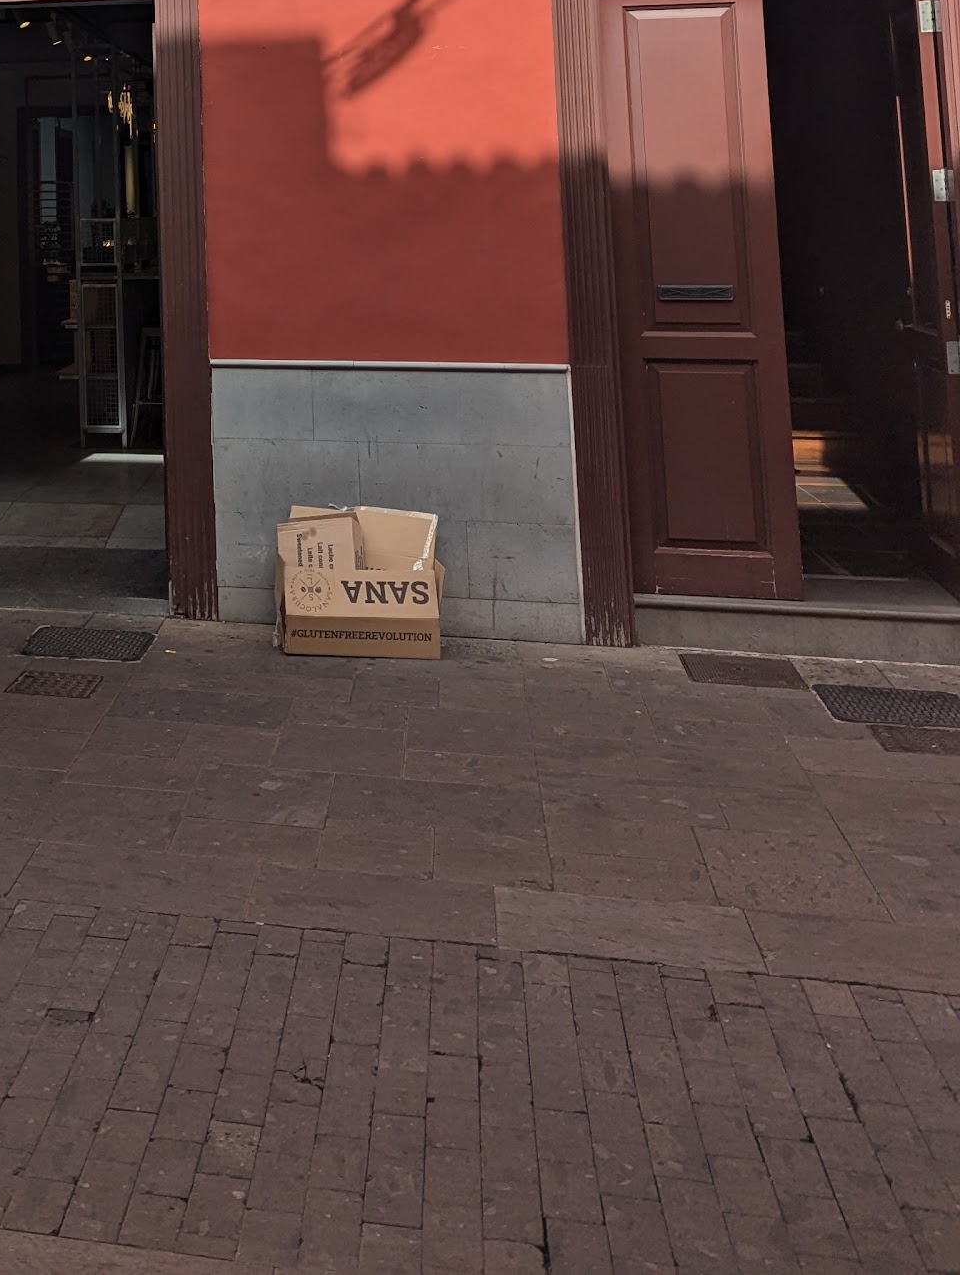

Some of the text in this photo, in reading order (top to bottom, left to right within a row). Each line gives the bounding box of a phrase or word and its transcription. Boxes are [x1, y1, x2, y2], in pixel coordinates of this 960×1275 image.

[296, 533, 304, 567] Sweetened
[341, 580, 430, 605] SANA
[290, 629, 433, 642] #GLUTENFREEREVOLUTION
